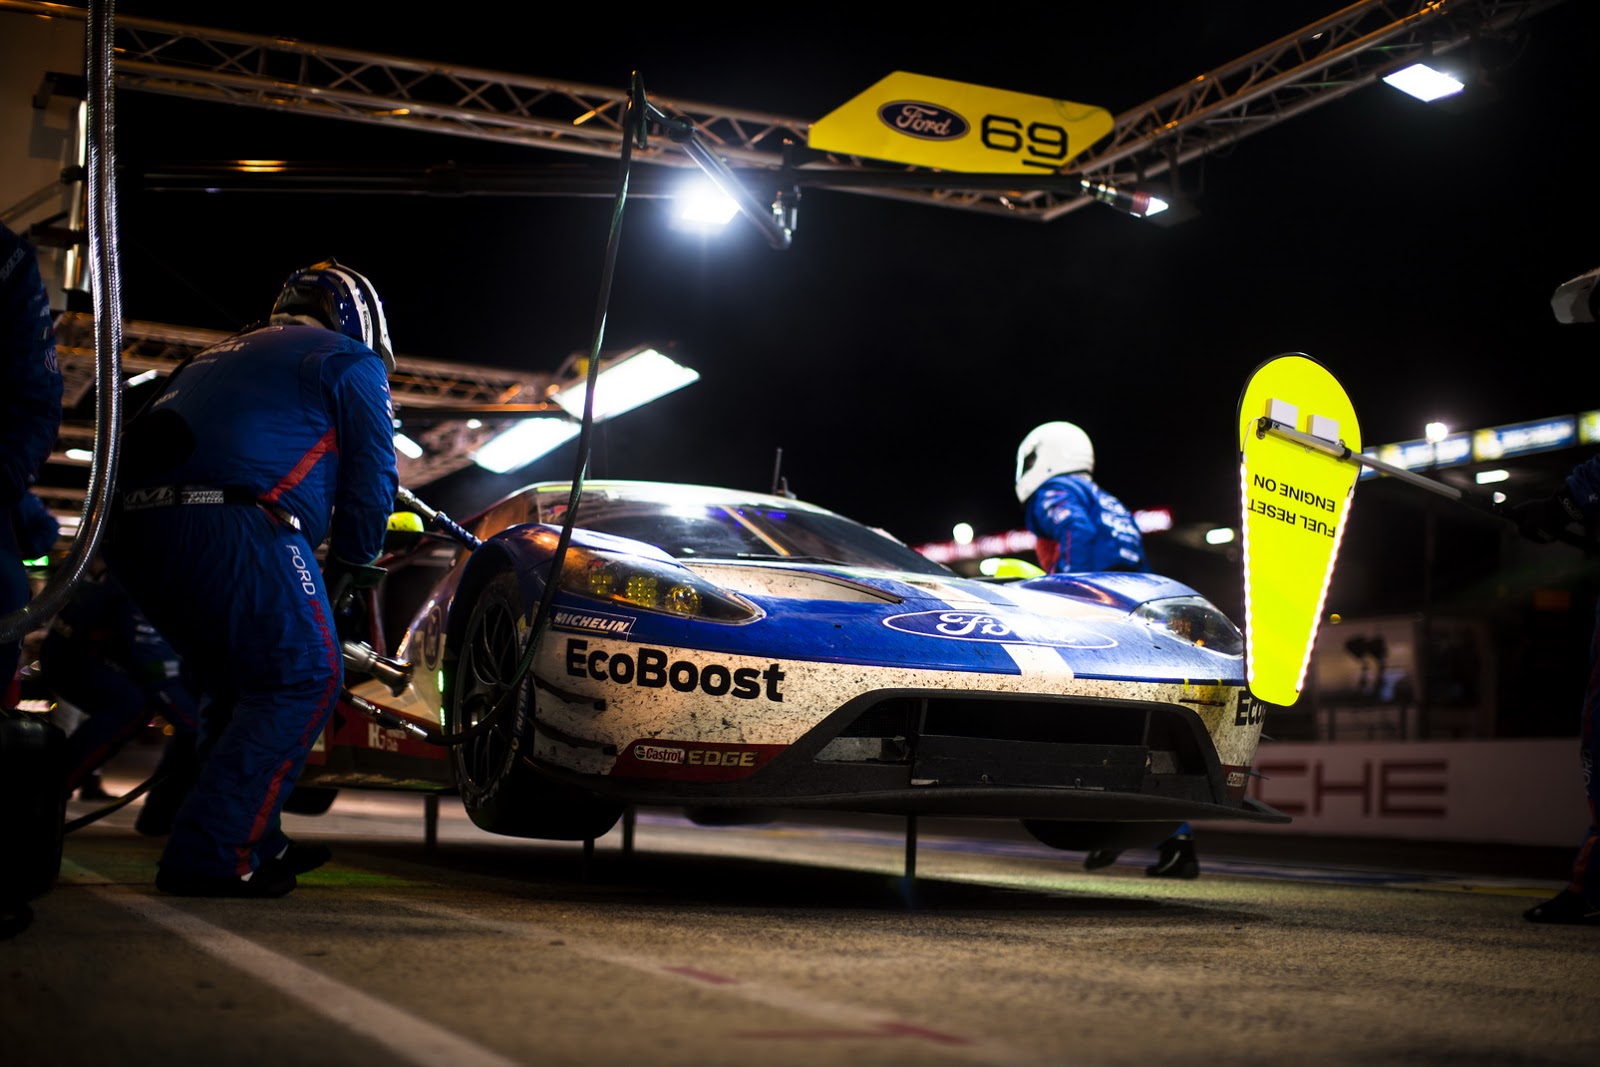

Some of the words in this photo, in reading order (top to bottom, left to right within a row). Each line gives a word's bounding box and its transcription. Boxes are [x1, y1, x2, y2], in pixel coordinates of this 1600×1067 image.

[896, 104, 952, 136] Ford
[980, 114, 1068, 160] 69
[1253, 473, 1277, 492] ON
[1279, 482, 1336, 512] ENGINE
[1248, 498, 1296, 525] RESET
[1299, 515, 1336, 538] FUEL
[286, 544, 316, 596] FORD
[553, 611, 631, 633] MICHELIN
[565, 638, 786, 703] EcoBoost
[645, 746, 683, 764] Castrol
[688, 750, 756, 768] EDGE
